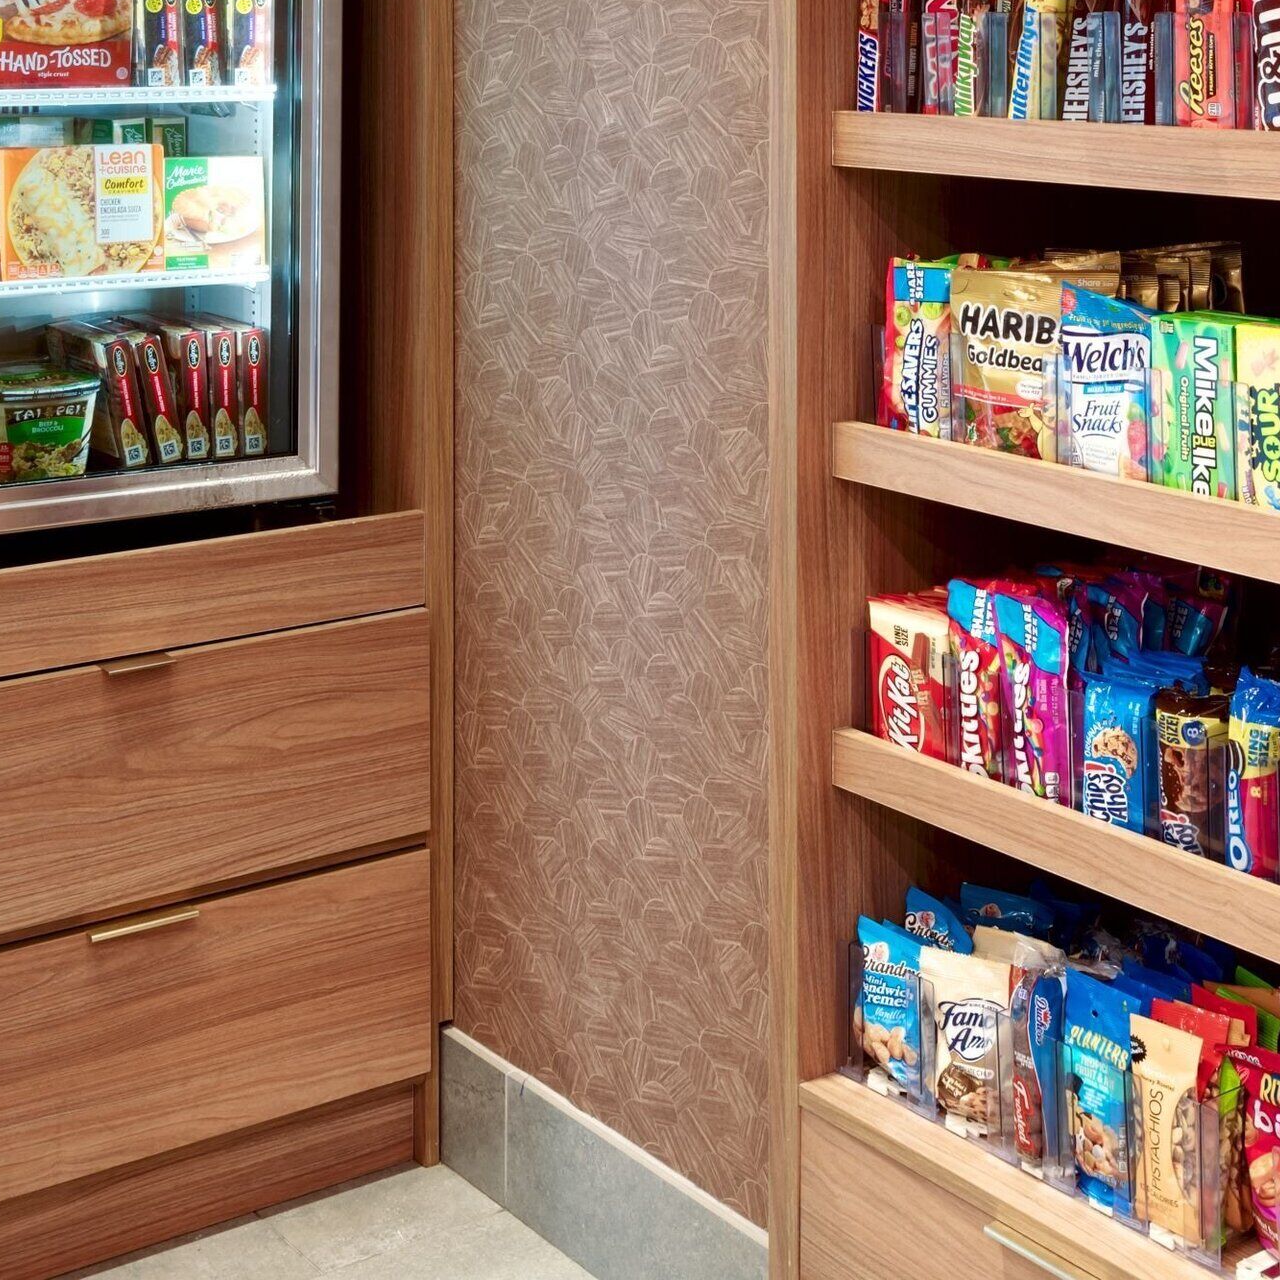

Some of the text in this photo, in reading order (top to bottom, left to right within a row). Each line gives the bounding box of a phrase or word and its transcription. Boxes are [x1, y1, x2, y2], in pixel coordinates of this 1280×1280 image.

[1179, 15, 1205, 116] Reese's
[101, 151, 146, 165] Lean
[105, 178, 144, 190] Comfort
[1063, 338, 1146, 373] Welch's
[919, 335, 939, 423] GUMMIES
[1194, 335, 1219, 438] Mike
[1084, 399, 1122, 418] Fruit
[1179, 376, 1190, 462] Original Fruits
[1192, 436, 1216, 448] and
[971, 588, 987, 639] SHARE
[893, 624, 902, 646] KING
[901, 626, 909, 648] SIZE
[1247, 729, 1260, 768] KING
[1258, 730, 1271, 768] SIZE
[1228, 770, 1250, 871] OREO
[1070, 1024, 1129, 1071] PLANTERS
[1147, 1088, 1165, 1192] PISTACHIOS
